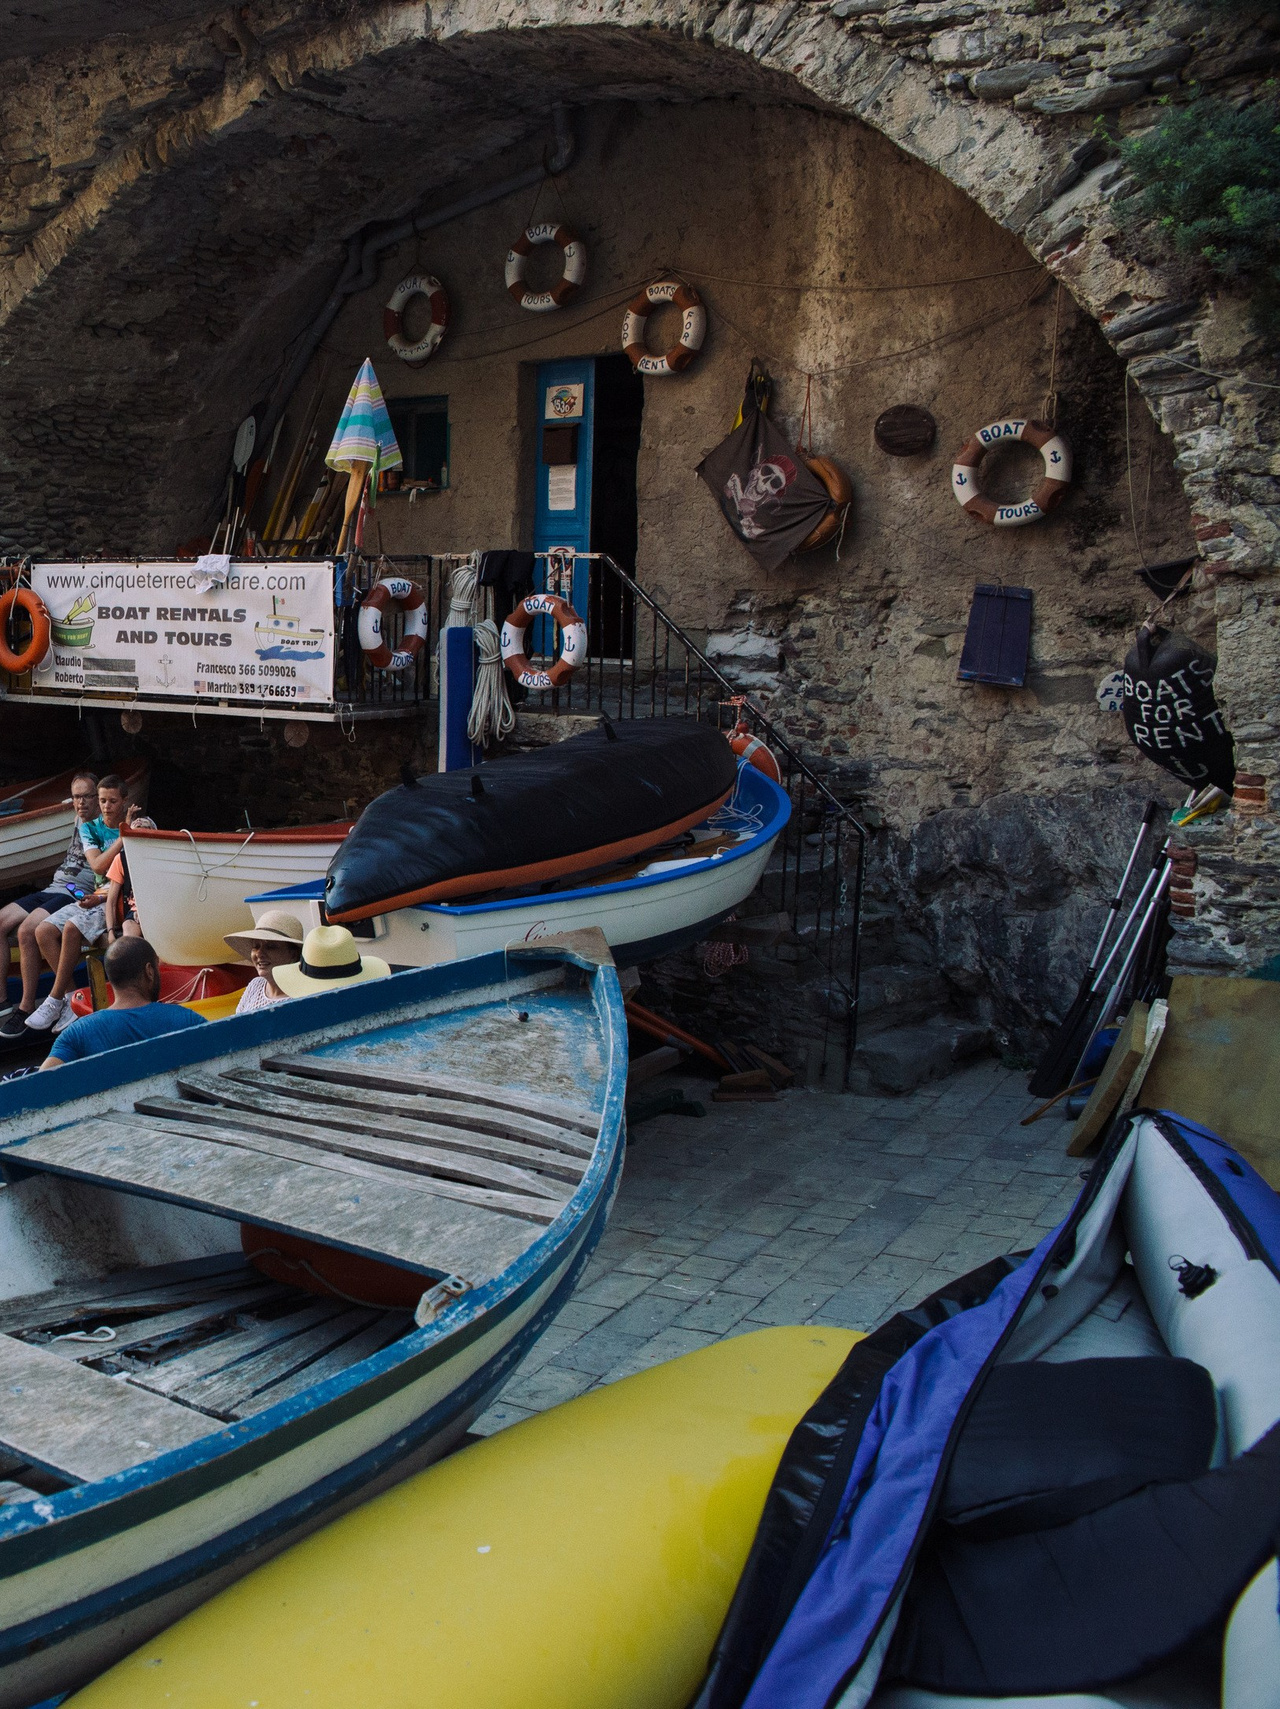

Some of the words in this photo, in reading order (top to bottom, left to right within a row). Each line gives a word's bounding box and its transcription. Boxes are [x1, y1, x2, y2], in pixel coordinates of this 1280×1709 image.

[528, 225, 556, 239] BOAT
[648, 285, 676, 297] BOATS
[523, 294, 551, 305] TOURS
[622, 312, 631, 342] FOR
[682, 310, 694, 342] FOR
[639, 358, 665, 370] RENT
[980, 421, 1024, 442] BOAT
[997, 501, 1040, 520] TOURS
[391, 582, 412, 594] BOAT
[524, 599, 555, 611] BOAT
[97, 606, 150, 620] BOAT
[156, 607, 247, 623] RENTALS
[115, 630, 158, 644] AND
[164, 631, 233, 647] TOURS
[280, 638, 300, 646] BOAT
[56, 655, 82, 667] Claudio
[196, 662, 236, 675] Francesco
[238, 664, 256, 676] 366
[258, 665, 297, 678] 5099026
[55, 671, 84, 684] Roberto
[521, 672, 551, 686] TOURS
[1123, 659, 1215, 701] BOATS
[207, 682, 237, 694] Martha
[1140, 698, 1196, 724] FOR
[1133, 708, 1224, 749] RENT
